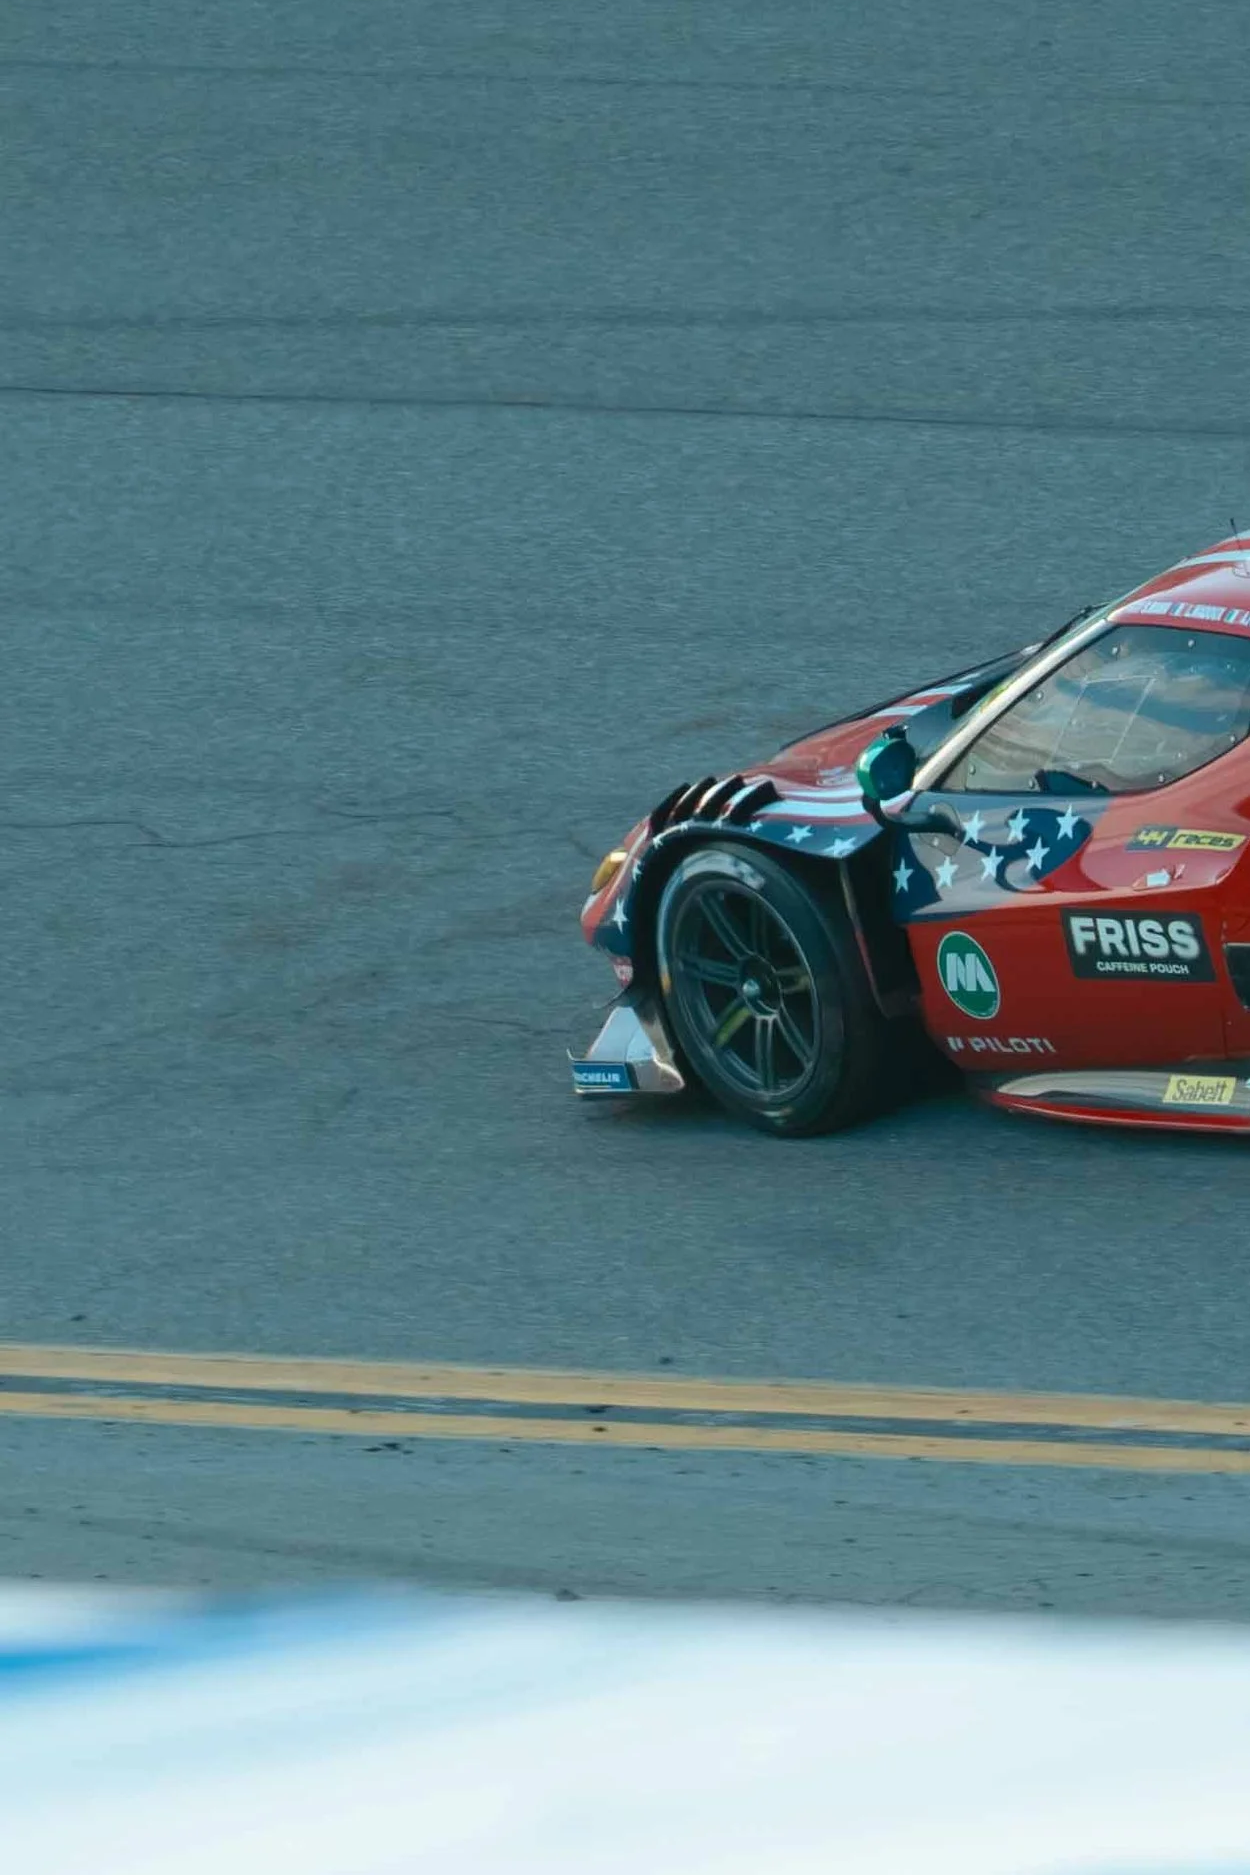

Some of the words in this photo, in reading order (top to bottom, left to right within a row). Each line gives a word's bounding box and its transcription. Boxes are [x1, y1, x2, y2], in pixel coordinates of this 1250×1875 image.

[1069, 916, 1200, 960] FRISS
[1096, 961, 1149, 973] CAFFEINE
[1150, 963, 1189, 974] POUCH
[968, 1036, 1056, 1053] PILOTI
